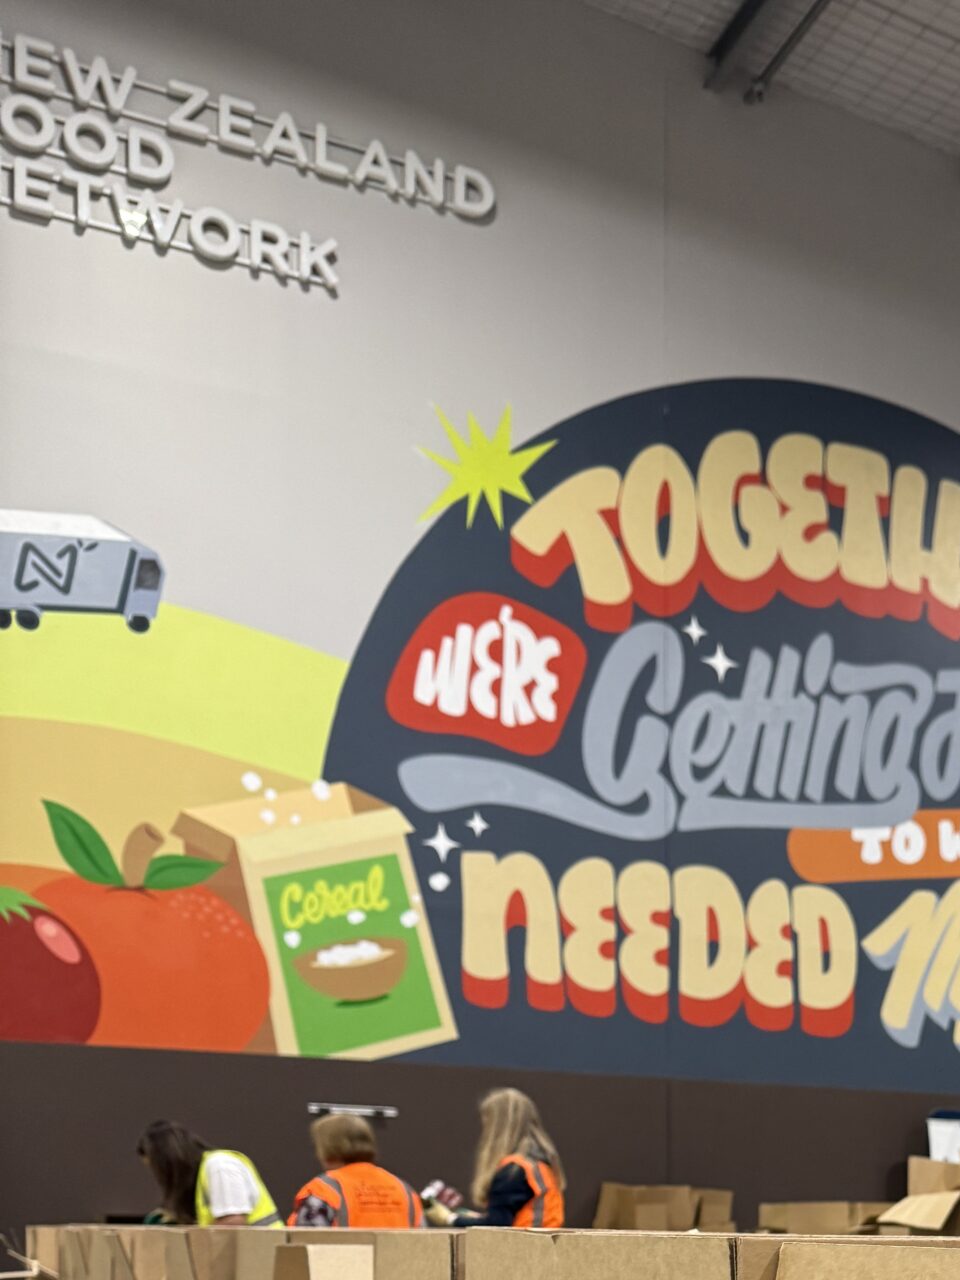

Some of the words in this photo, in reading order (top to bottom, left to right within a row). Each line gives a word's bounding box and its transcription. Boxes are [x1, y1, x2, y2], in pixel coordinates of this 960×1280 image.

[0, 33, 138, 115] EW
[166, 78, 496, 220] ZEALAND
[0, 93, 175, 186] OOD
[0, 156, 338, 290] ETWORK
[580, 618, 934, 834] Getting
[281, 865, 389, 929] Cereal
[851, 819, 927, 866] TO
[461, 850, 857, 1038] NEEDED
